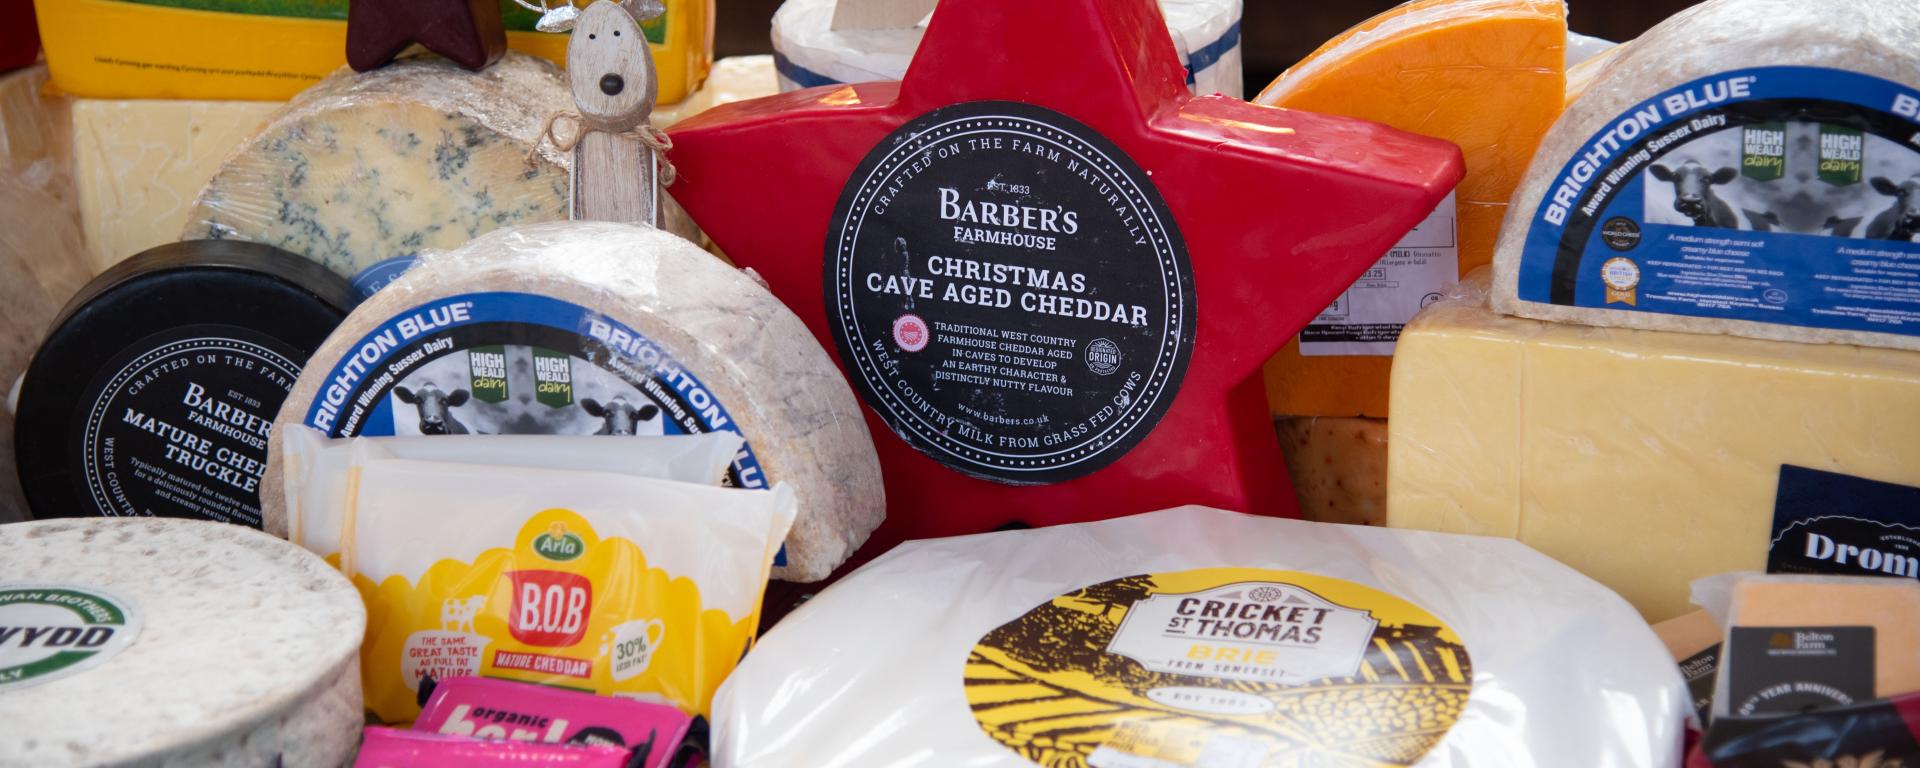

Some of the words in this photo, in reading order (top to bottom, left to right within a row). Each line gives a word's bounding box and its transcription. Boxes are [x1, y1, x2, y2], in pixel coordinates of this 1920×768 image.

[1744, 129, 1784, 146] HIGH
[1745, 144, 1784, 156] WEALD
[1821, 133, 1862, 150] HIGH
[1544, 103, 1663, 227] BRIGHTON
[1664, 76, 1751, 117] BLUE
[1821, 148, 1861, 161] WEALD
[1581, 183, 1613, 217] Award
[1607, 149, 1651, 186] Winning
[1647, 126, 1692, 152] Sussex
[1691, 113, 1727, 131] Dairy
[1744, 153, 1783, 176] dairy
[1820, 158, 1860, 181] dairy
[874, 156, 932, 215] CRAFTED
[938, 143, 960, 159] ON
[968, 137, 1003, 151] THE
[1012, 139, 1061, 163] FARM
[1067, 159, 1147, 246] NATURALLY
[1009, 184, 1030, 195] 1833
[953, 226, 1057, 251] FARMHOUSE
[927, 255, 1086, 294] CHRISTMAS
[866, 272, 934, 299] CAVE
[943, 283, 1011, 309] AGED
[1020, 292, 1149, 327] CHEDDAR
[396, 301, 471, 341] BLUE
[934, 321, 999, 338] TRADITIONAL
[1001, 329, 1028, 341] WEST
[1030, 334, 1077, 348] COUNTRY
[937, 334, 997, 349] FARMHOUSE
[999, 343, 1045, 356] CHEDDAR
[1047, 349, 1073, 360] AGED
[470, 351, 505, 369] HIGH
[535, 356, 570, 373] HIGH
[952, 348, 963, 357] IN
[965, 350, 996, 362] CAVES
[998, 354, 1010, 364] TO
[1013, 356, 1057, 370] DEVELOP
[1089, 351, 1117, 364] ORIGIN
[128, 358, 190, 396] CRAFTED
[196, 354, 217, 365] ON
[225, 355, 254, 370] THE
[472, 367, 505, 379] WEALD
[536, 370, 570, 383] WEALD
[588, 319, 728, 431] BRIGHTON
[935, 370, 990, 385] DISTINCTLY
[993, 379, 1026, 391] NUTTY
[1028, 383, 1073, 397] FLAVOUR
[942, 359, 956, 369] AN
[958, 361, 998, 374] EARTHY
[999, 366, 1058, 382] CHARACTER
[1060, 375, 1067, 384] &
[340, 408, 365, 438] Award
[359, 370, 394, 409] Winning
[390, 349, 425, 375] Sussex
[424, 335, 454, 356] Dairy
[473, 375, 507, 399] dairy
[536, 379, 571, 403] dairy
[608, 357, 644, 383] Award
[645, 376, 686, 422] Winning
[872, 339, 899, 377] WEST
[897, 379, 955, 428] COUNTRY
[958, 425, 994, 445] MILK
[999, 436, 1039, 449] FROM
[1043, 423, 1088, 447] GRASS
[1089, 405, 1114, 428] FED
[1113, 371, 1141, 406] COWS
[957, 402, 1050, 426] www.barbers.co.uk
[122, 407, 213, 455] MATURE
[187, 410, 267, 450] FARMHOUSE
[103, 436, 116, 469] WEST
[165, 444, 258, 493] TRUCKLE
[106, 471, 140, 517] COUNTR
[131, 456, 167, 478] Typically
[167, 473, 202, 491] matured
[202, 485, 214, 497] for
[215, 490, 241, 508] twelve
[134, 469, 147, 480] for
[154, 477, 198, 500] deliciously
[199, 495, 232, 515] rounded
[232, 508, 260, 525] flavour
[155, 488, 171, 501] and
[171, 495, 201, 513] creamy
[540, 537, 576, 555] Arla
[1804, 532, 1919, 579] Drom
[44, 592, 112, 623] BROTHERS
[519, 582, 587, 635] B.O.B
[1176, 597, 1335, 625] CRICKET
[421, 636, 439, 646] THE
[441, 636, 466, 646] SAME
[1168, 616, 1193, 629] ST
[1197, 619, 1323, 644] THOMAS
[1794, 631, 1834, 641] Belton
[410, 648, 445, 658] GREAT
[447, 647, 478, 657] TASTE
[616, 635, 647, 660] 30%
[1186, 644, 1280, 665] BRIE
[1795, 640, 1826, 649] Farm
[420, 658, 434, 666] AS
[435, 657, 454, 666] FULL
[456, 657, 469, 666] FAT
[496, 652, 532, 670] MATURE
[533, 656, 588, 677] CHEDDAR
[1168, 659, 1204, 670] FROM
[1214, 663, 1286, 677] SOMERSET
[1760, 683, 1792, 700] YEAR
[472, 706, 549, 729] organic
